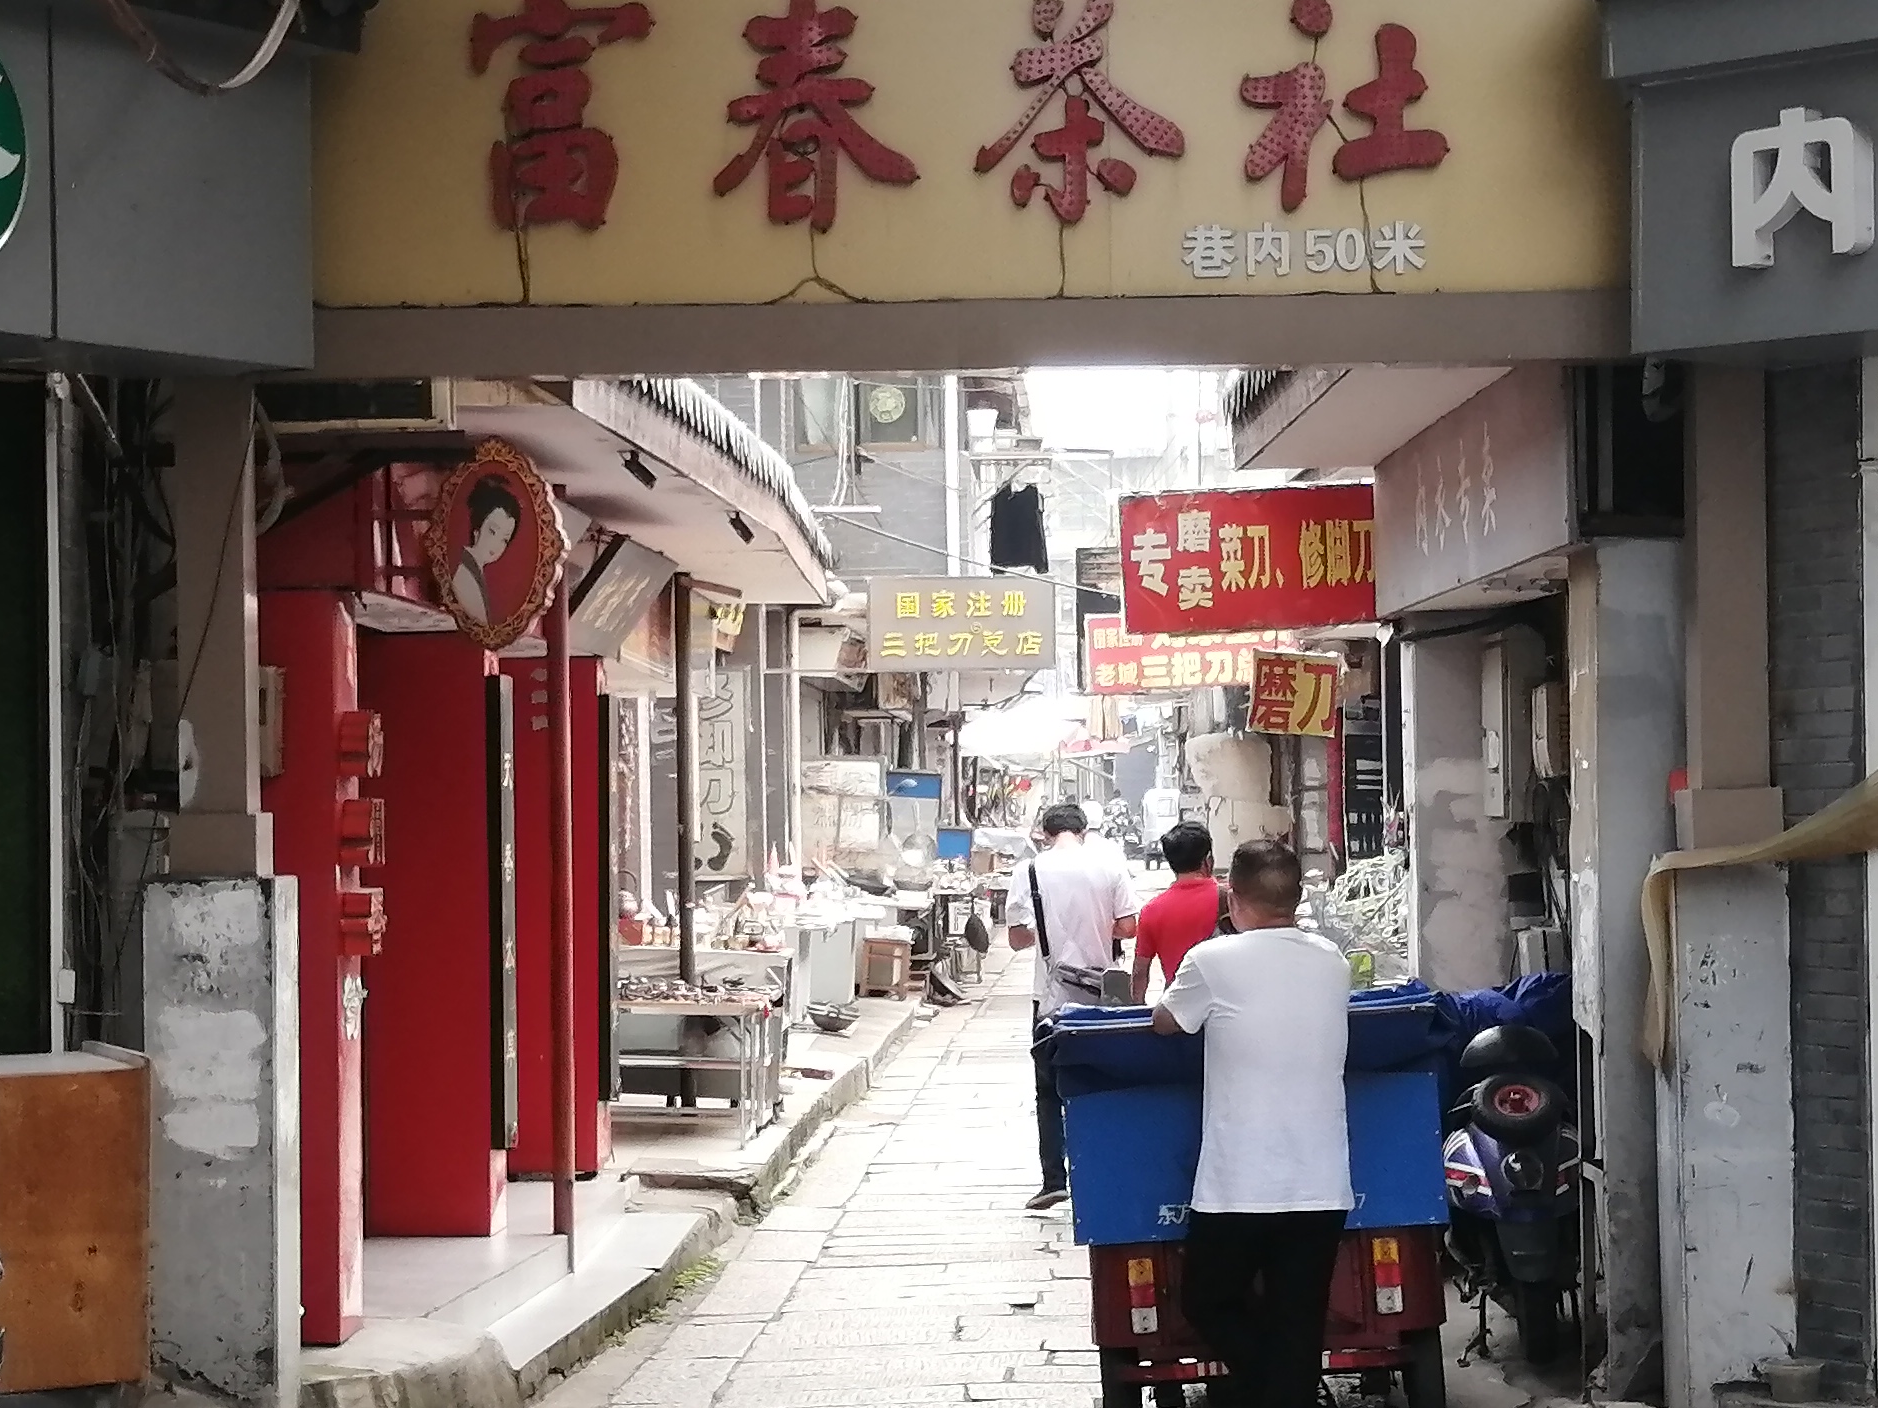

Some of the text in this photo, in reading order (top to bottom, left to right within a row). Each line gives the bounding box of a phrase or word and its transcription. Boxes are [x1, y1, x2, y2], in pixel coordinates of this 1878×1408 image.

[1181, 223, 1427, 280] 巷内50米
[895, 590, 1026, 619] 国家注册
[1249, 658, 1339, 733] 磨刀
